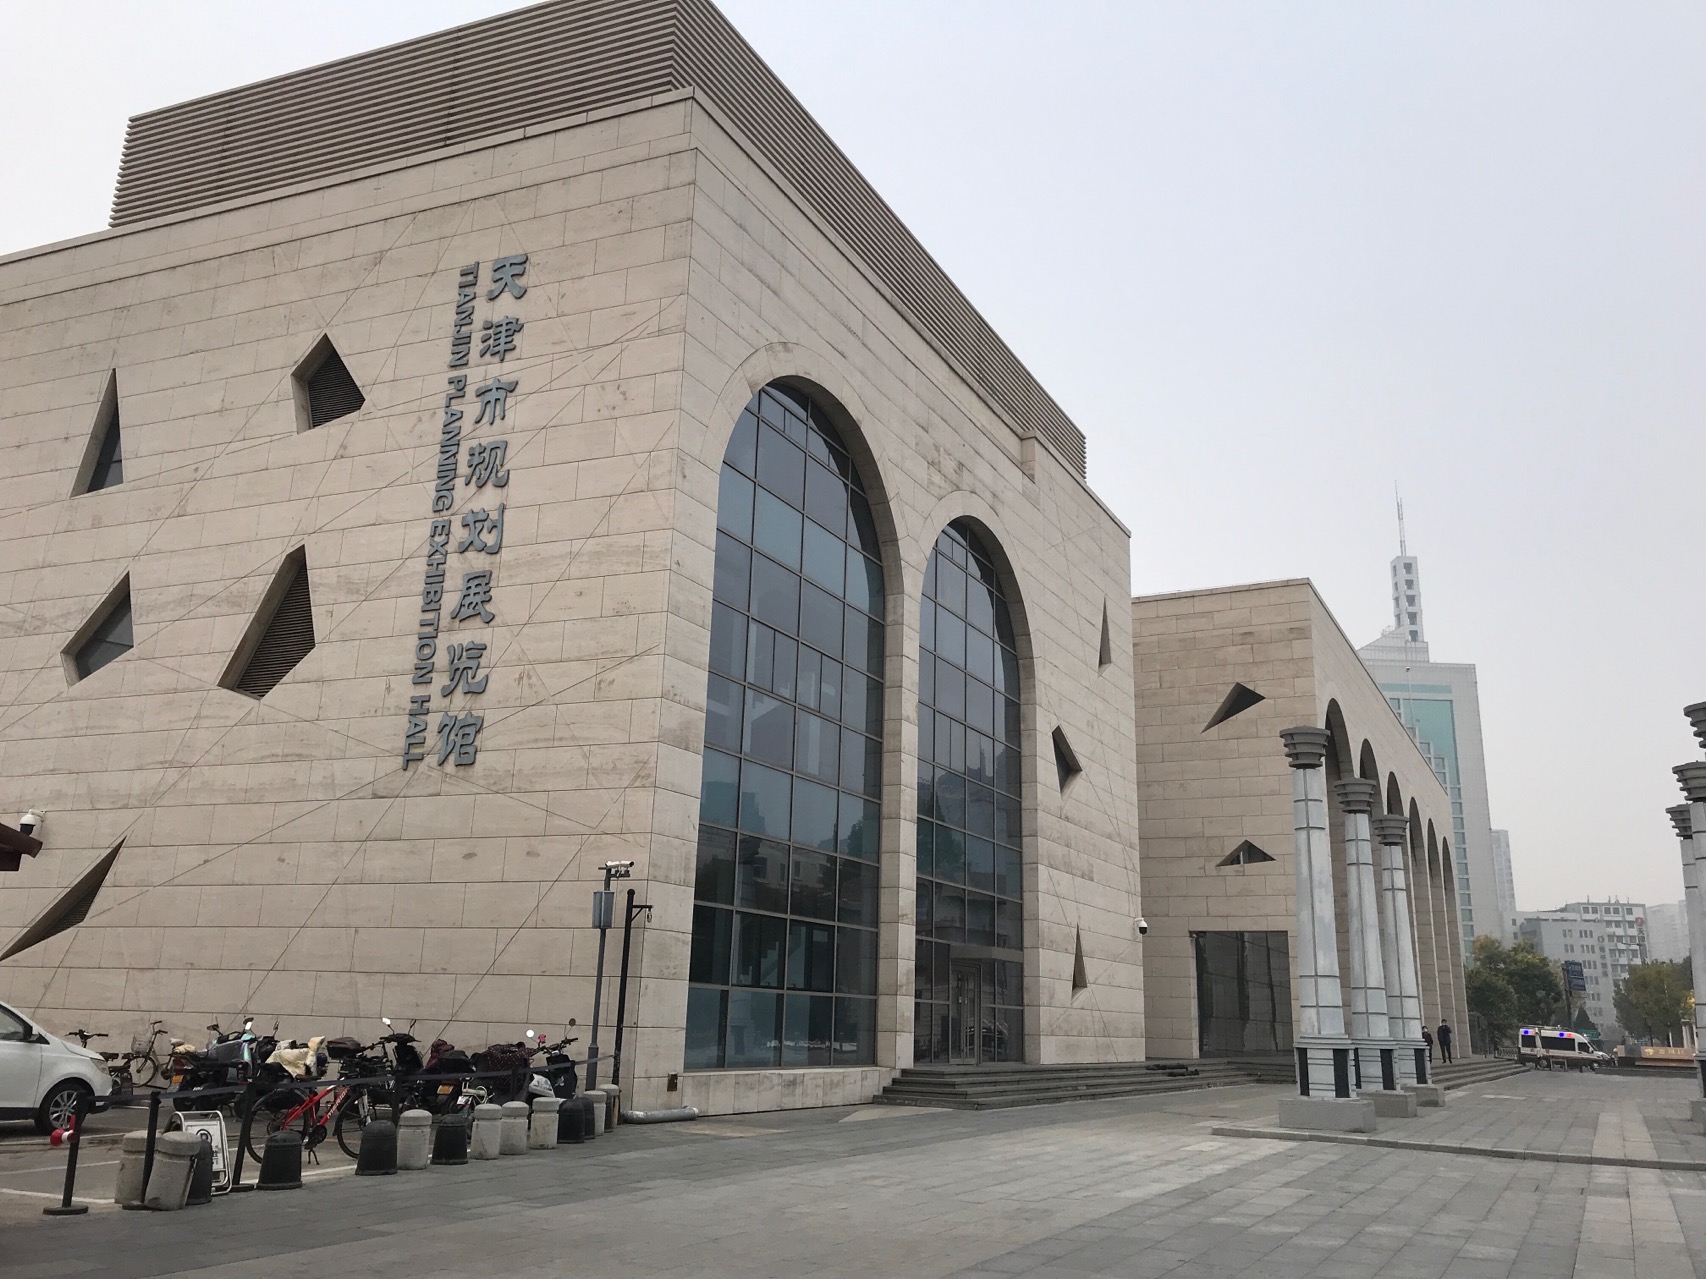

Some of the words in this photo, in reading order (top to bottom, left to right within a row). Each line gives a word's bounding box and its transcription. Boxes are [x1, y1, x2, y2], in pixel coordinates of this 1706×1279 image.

[449, 261, 480, 367] TIANJIN
[432, 374, 467, 513] PLANNING
[437, 254, 528, 766] 天津市规划展览馆
[412, 519, 452, 685] EXHIBITION
[402, 694, 431, 771] HALL
